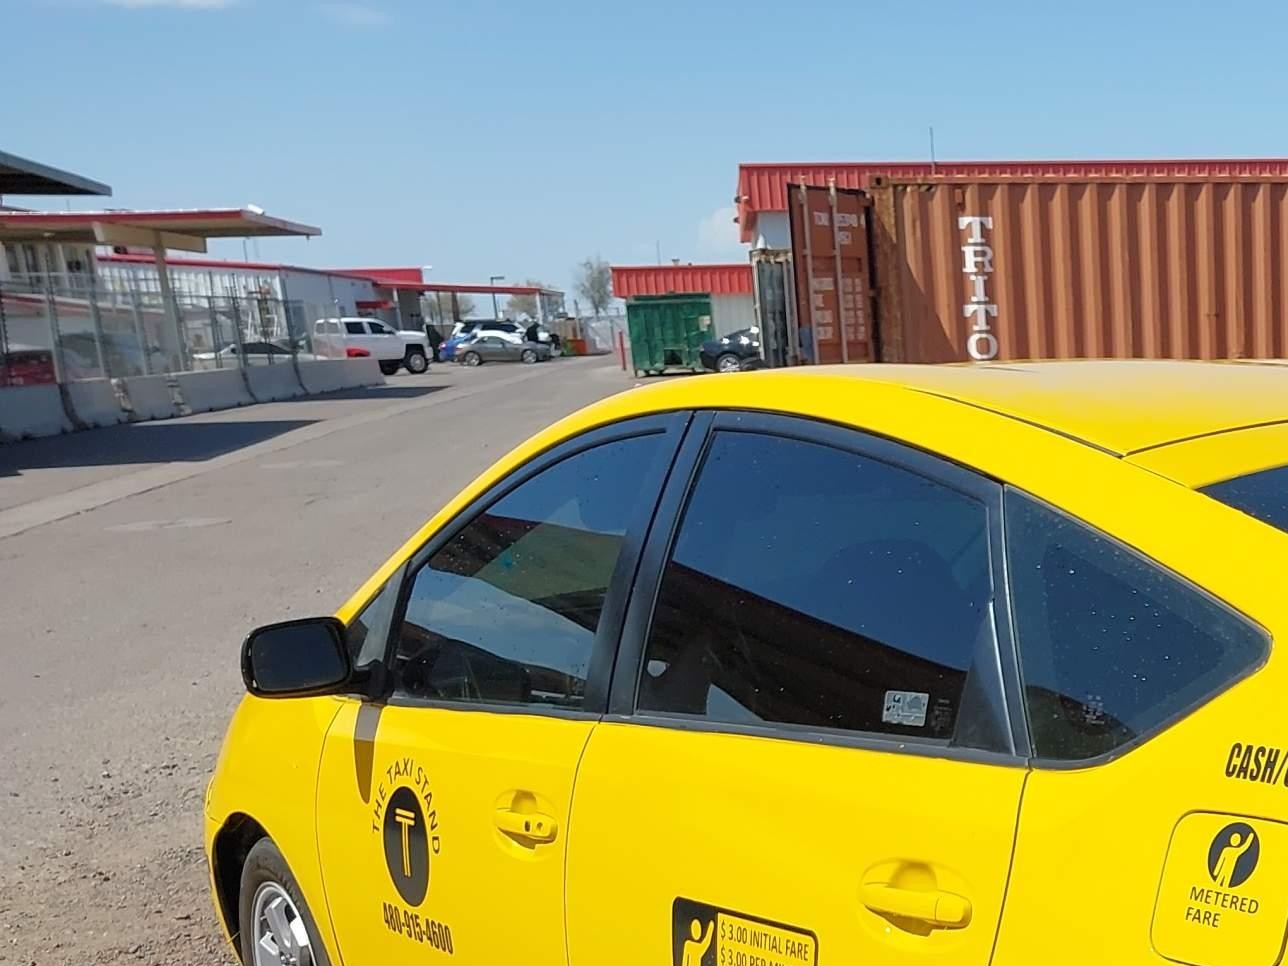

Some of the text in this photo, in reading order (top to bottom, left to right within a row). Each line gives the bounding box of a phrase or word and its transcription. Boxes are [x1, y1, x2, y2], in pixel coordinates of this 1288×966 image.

[372, 757, 441, 855] THE TAXI STAND
[1189, 886, 1259, 915] METERED
[382, 901, 454, 955] 480-915-4600
[1185, 906, 1221, 928] FARE
[749, 929, 782, 954] INITIAL
[785, 939, 809, 961] FARE
